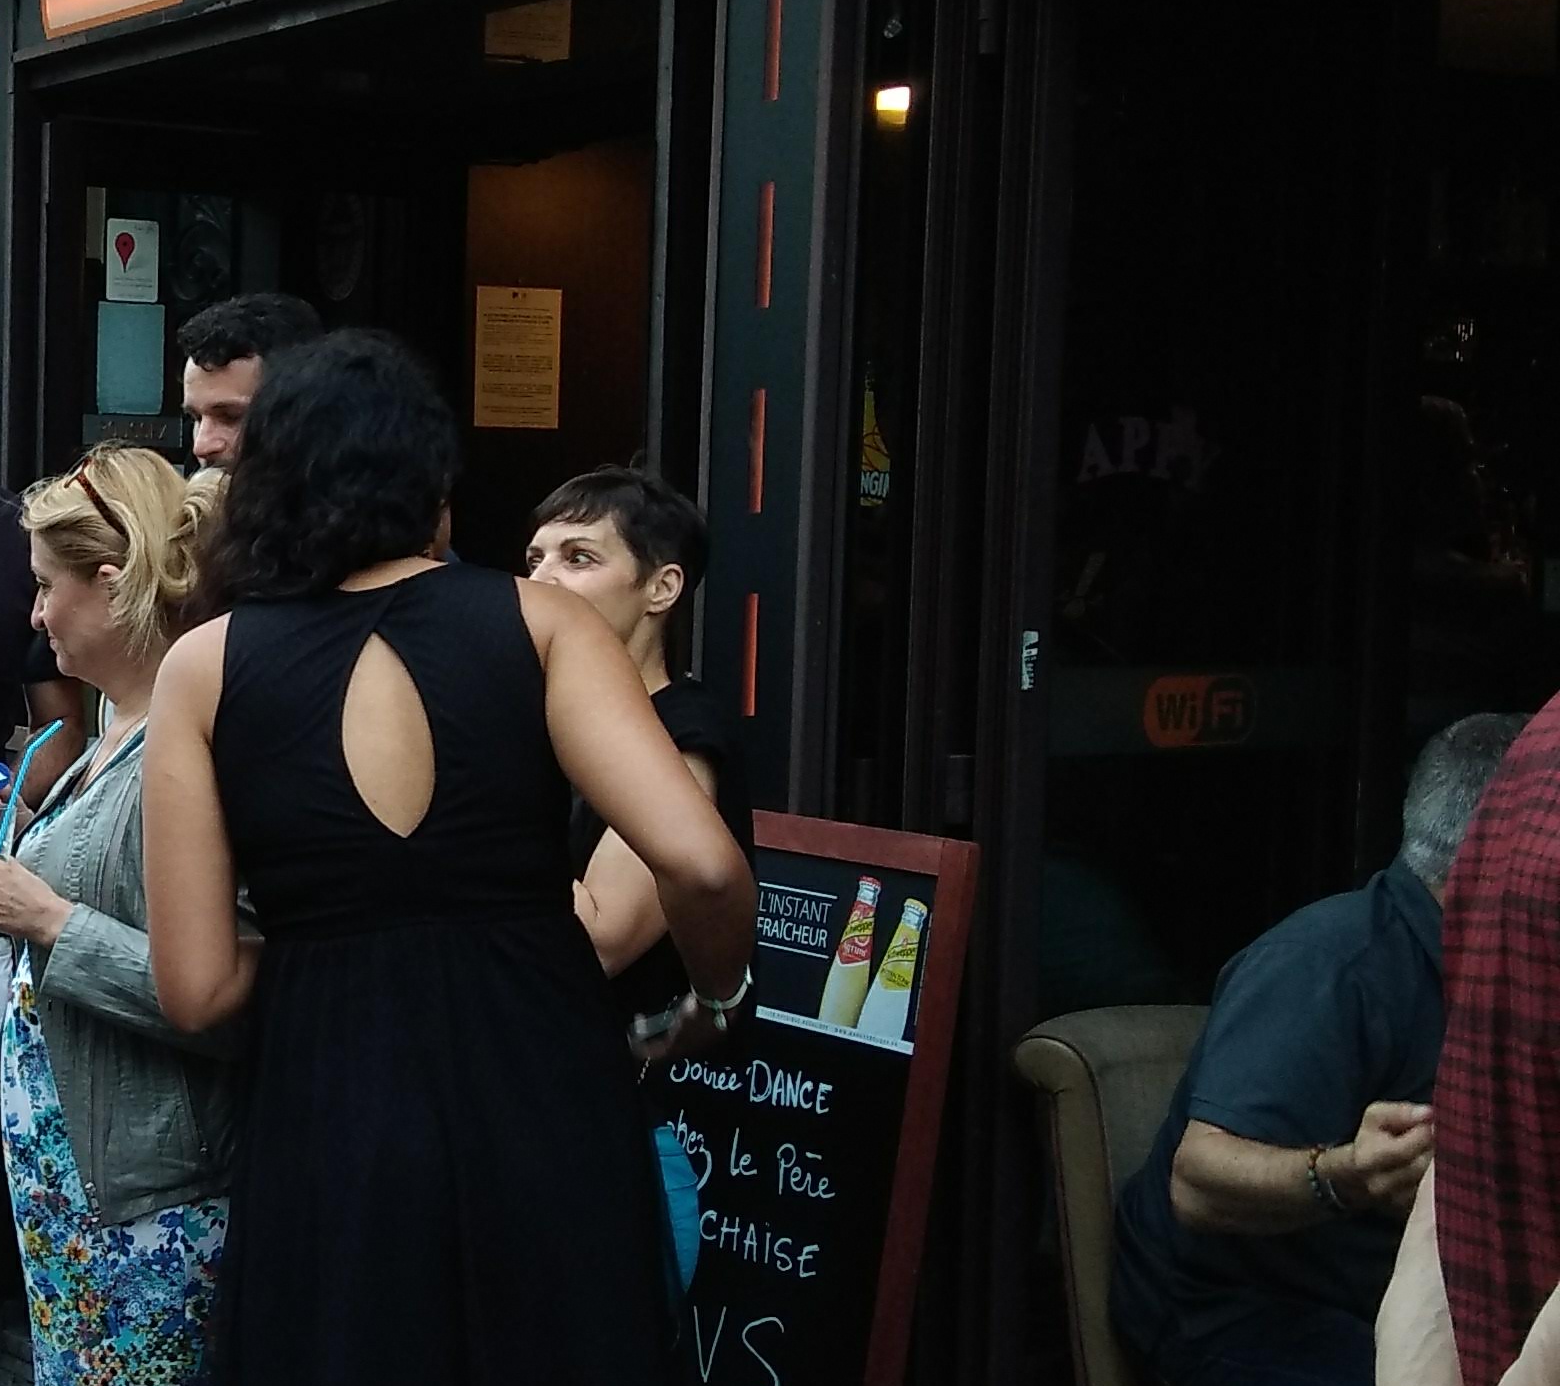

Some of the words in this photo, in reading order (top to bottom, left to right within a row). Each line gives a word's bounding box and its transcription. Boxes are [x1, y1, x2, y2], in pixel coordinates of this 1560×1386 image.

[758, 889, 833, 924] L'INSTANT
[756, 916, 829, 949] FRAÎCHEUR
[746, 1058, 834, 1115] DANCE
